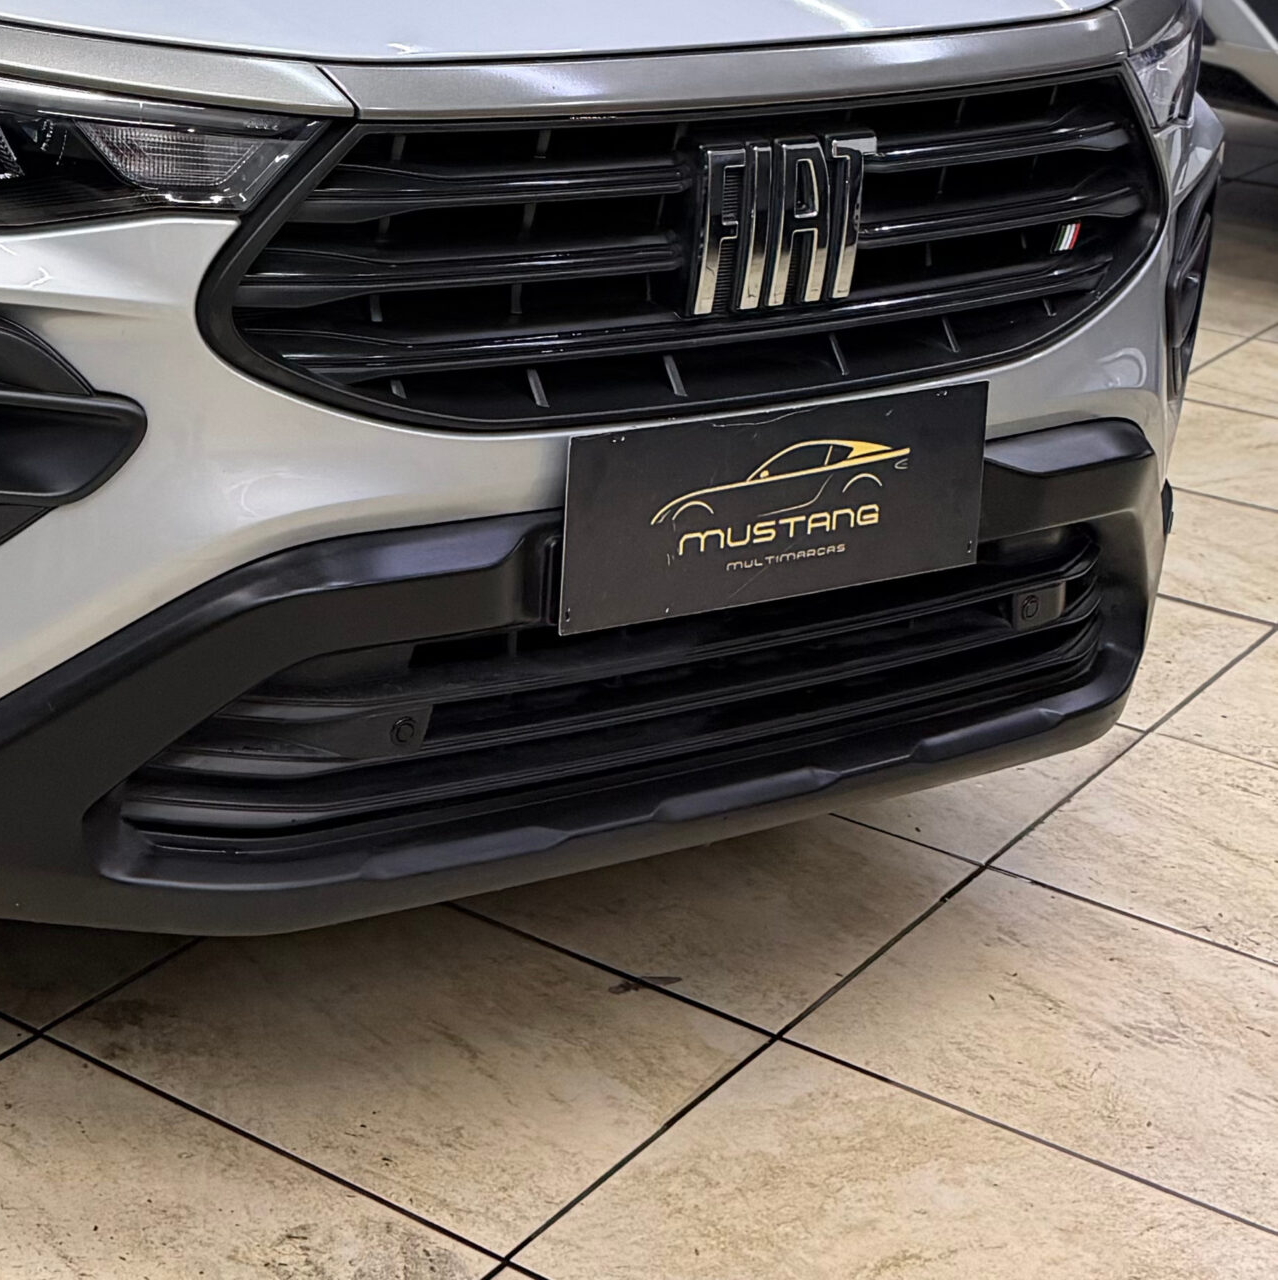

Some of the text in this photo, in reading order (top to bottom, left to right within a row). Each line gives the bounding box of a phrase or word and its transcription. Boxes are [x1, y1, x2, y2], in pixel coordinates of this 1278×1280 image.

[687, 128, 878, 317] FIAT
[677, 503, 881, 556] MUSTANG
[725, 543, 847, 572] MULTIMARCAS
